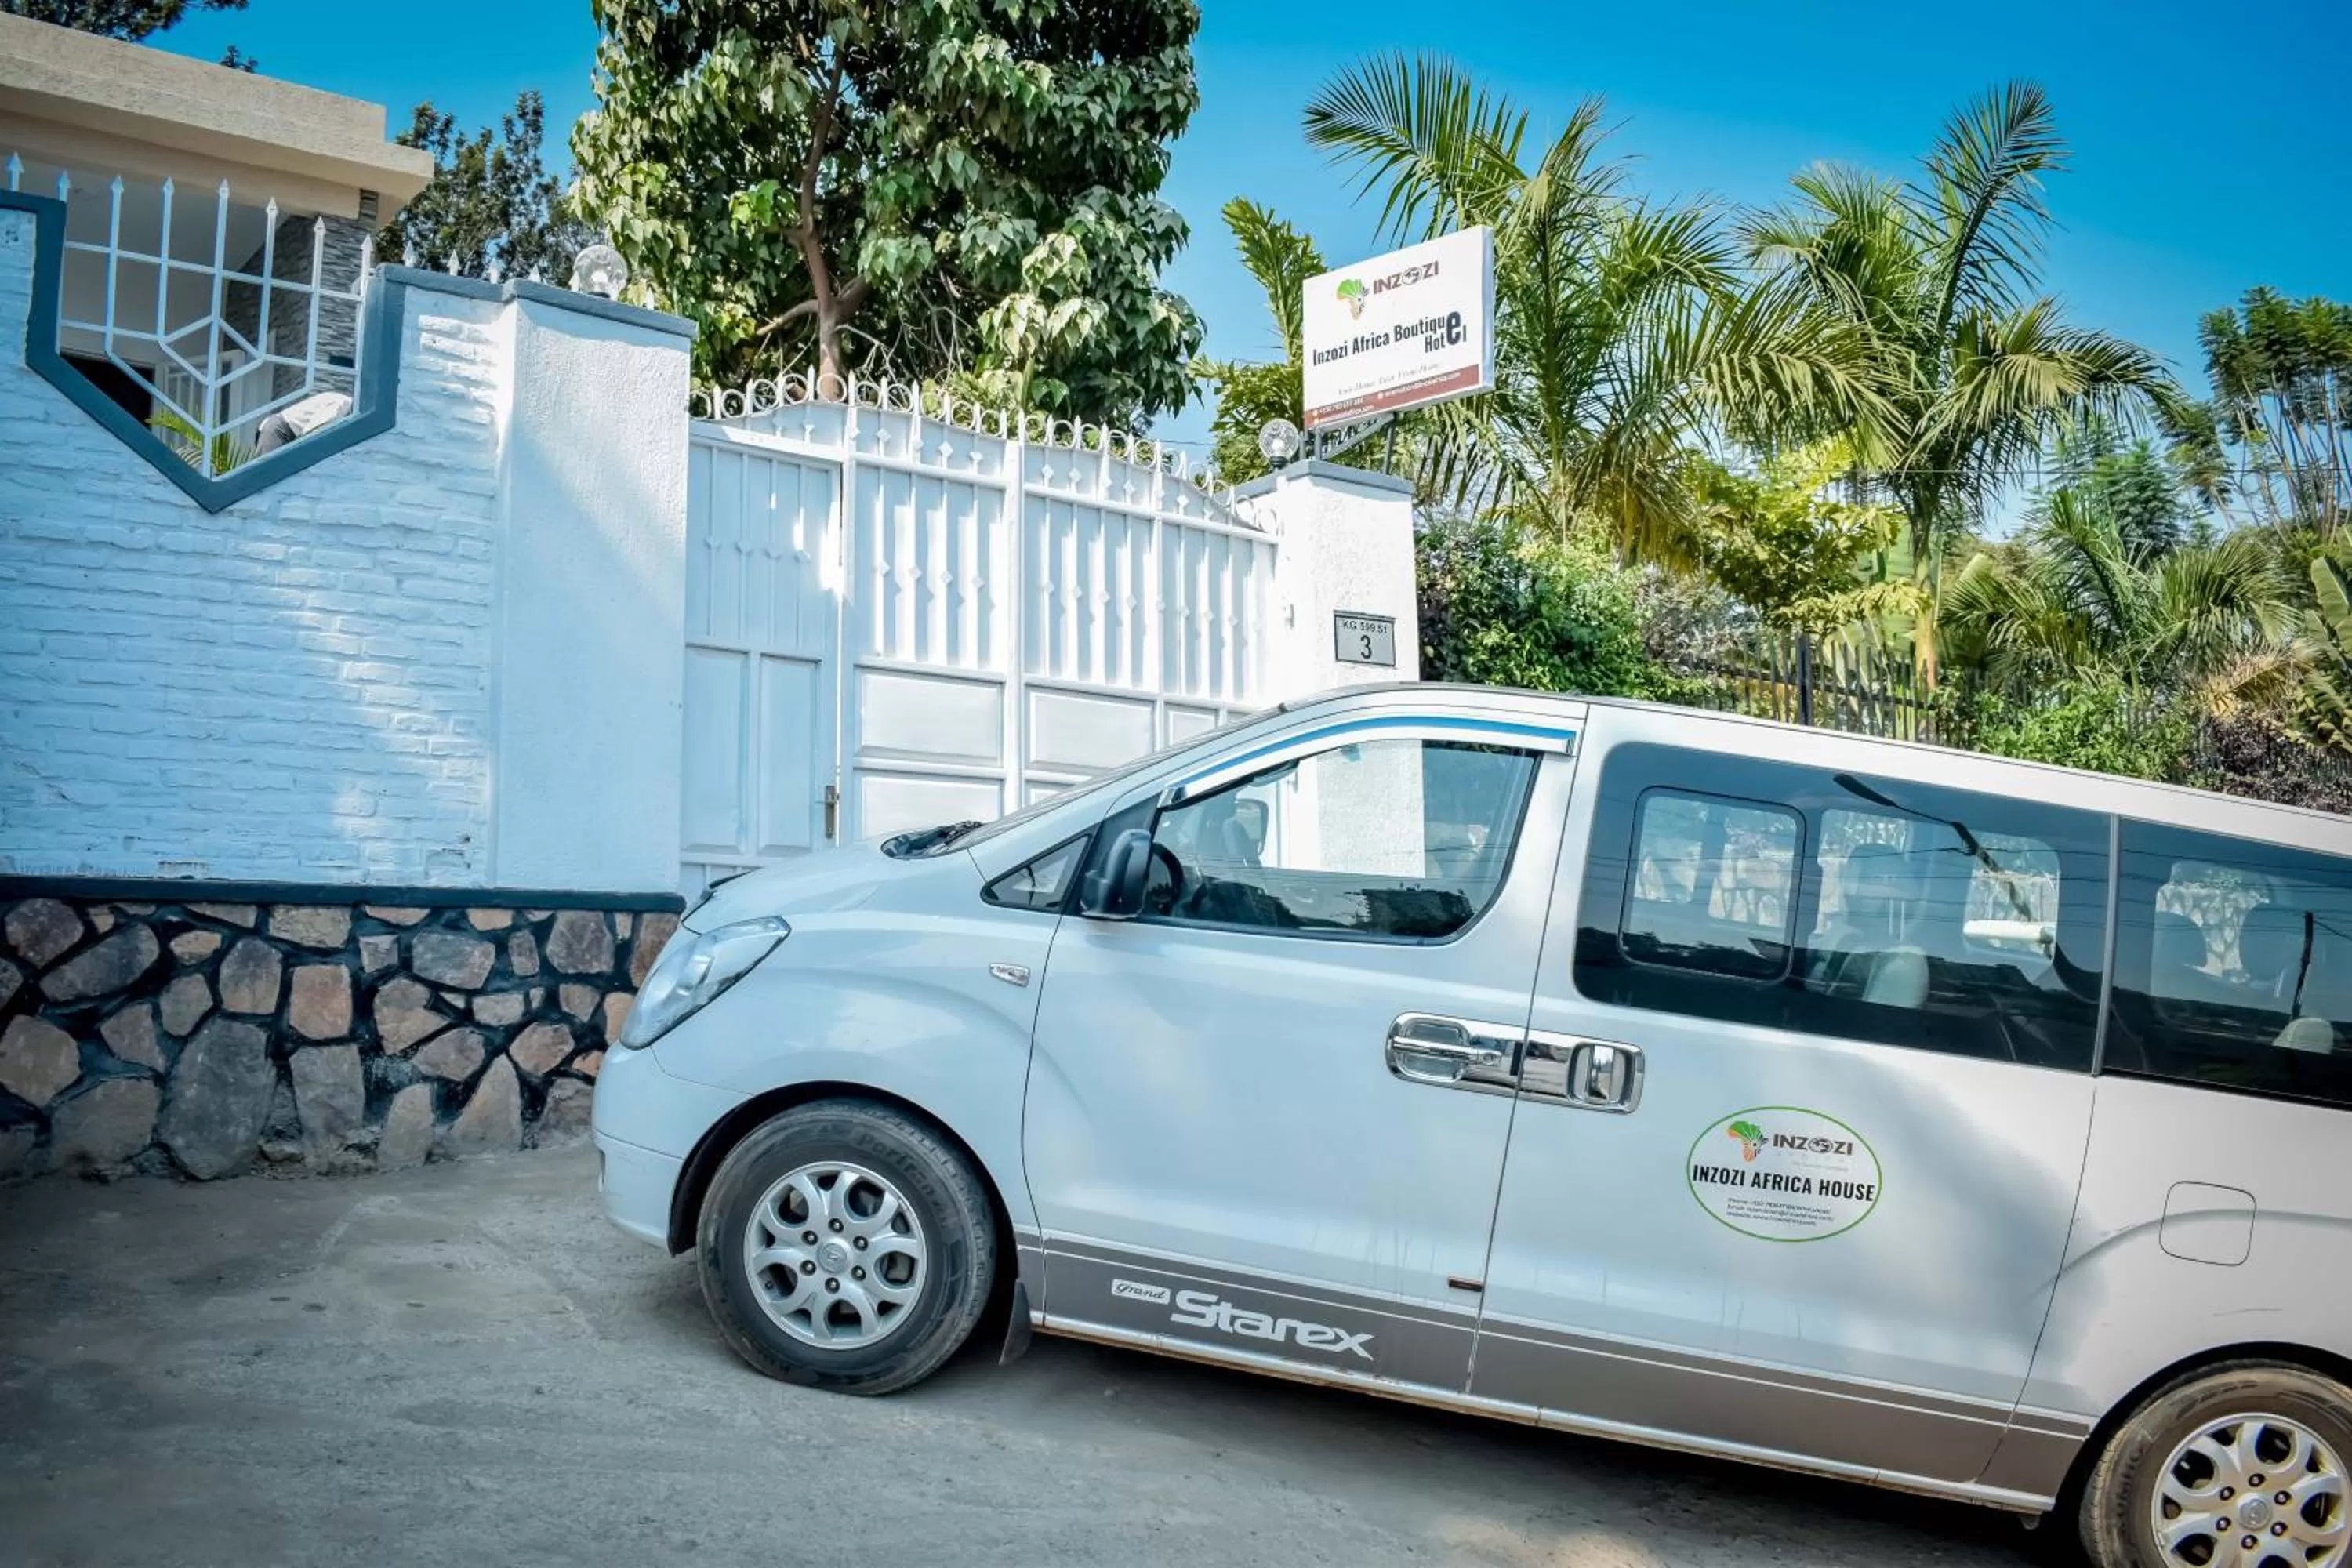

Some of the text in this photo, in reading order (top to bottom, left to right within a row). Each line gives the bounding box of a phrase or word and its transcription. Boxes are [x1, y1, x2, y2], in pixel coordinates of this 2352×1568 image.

[1373, 260, 1439, 294] INZOZI
[1312, 340, 1348, 366] Inzozi
[1352, 332, 1390, 354] Africa
[1360, 634, 1372, 659] 3
[1773, 1134, 1853, 1156] INZOZI
[1693, 1164, 1875, 1201] INZOZI AFRICA HOUSE
[1171, 1290, 1374, 1361] Starex
